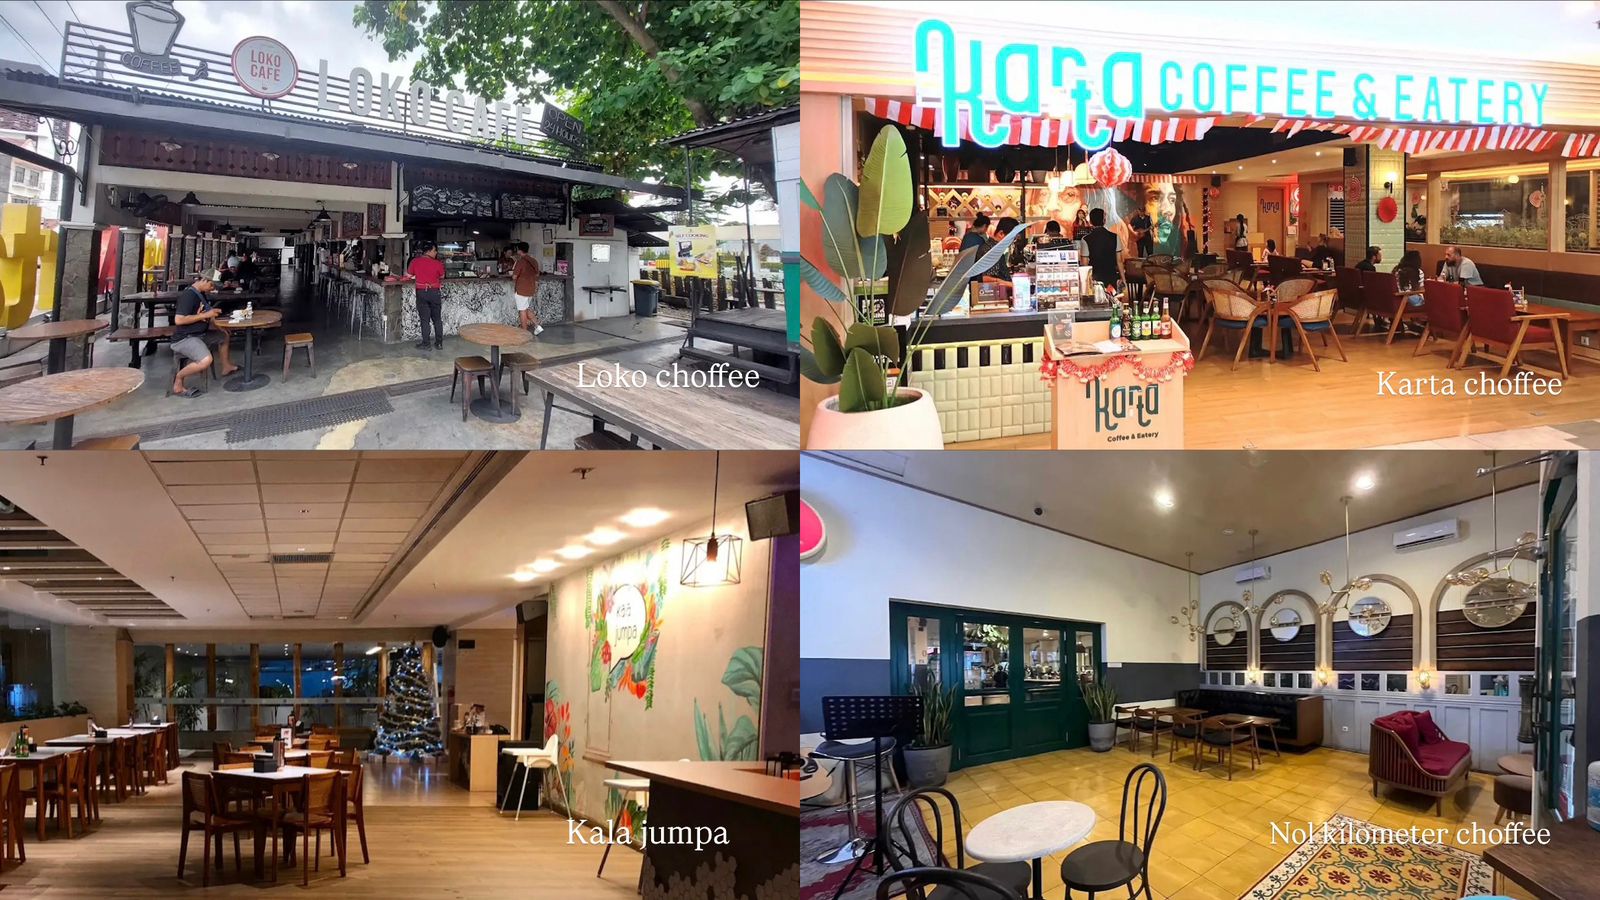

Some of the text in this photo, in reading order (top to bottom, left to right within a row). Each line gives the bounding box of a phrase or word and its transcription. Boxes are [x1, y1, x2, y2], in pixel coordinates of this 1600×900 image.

[122, 52, 179, 74] COFFEE
[251, 50, 281, 67] LOKO
[251, 65, 281, 82] CAFE
[317, 58, 531, 145] LOKO CAFE
[1159, 60, 1336, 119] COFFEE
[1352, 73, 1378, 120] &
[1394, 75, 1549, 127] EATERY
[543, 120, 582, 146] 24 HOURS
[548, 108, 582, 134] OPEN
[1107, 433, 1130, 443] Coffee
[1136, 431, 1159, 440] Eatery
